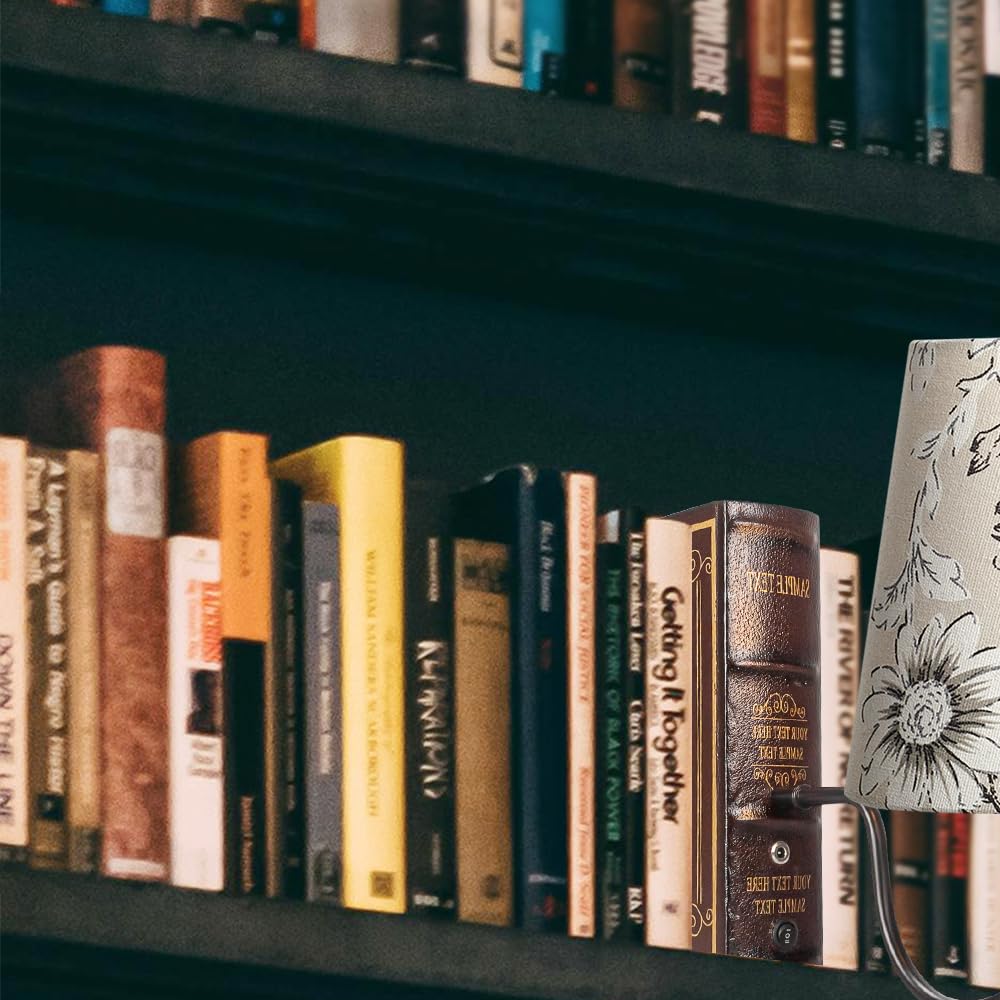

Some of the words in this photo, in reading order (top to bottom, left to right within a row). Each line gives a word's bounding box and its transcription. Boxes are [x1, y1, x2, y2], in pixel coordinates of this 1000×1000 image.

[47, 460, 66, 476] A
[629, 532, 644, 558] The
[606, 569, 621, 598] THE
[838, 574, 855, 623] THE
[629, 632, 644, 673] Lover
[652, 586, 686, 682] Getting
[838, 629, 855, 705] RIVER
[606, 689, 621, 712] OF
[661, 686, 686, 703] It
[628, 699, 643, 741] Chris
[838, 711, 855, 744] OF
[0, 720, 14, 763] THE
[606, 718, 621, 769] BLACK
[652, 707, 686, 825] Together
[0, 773, 14, 824] LINE
[606, 777, 621, 841] POWER
